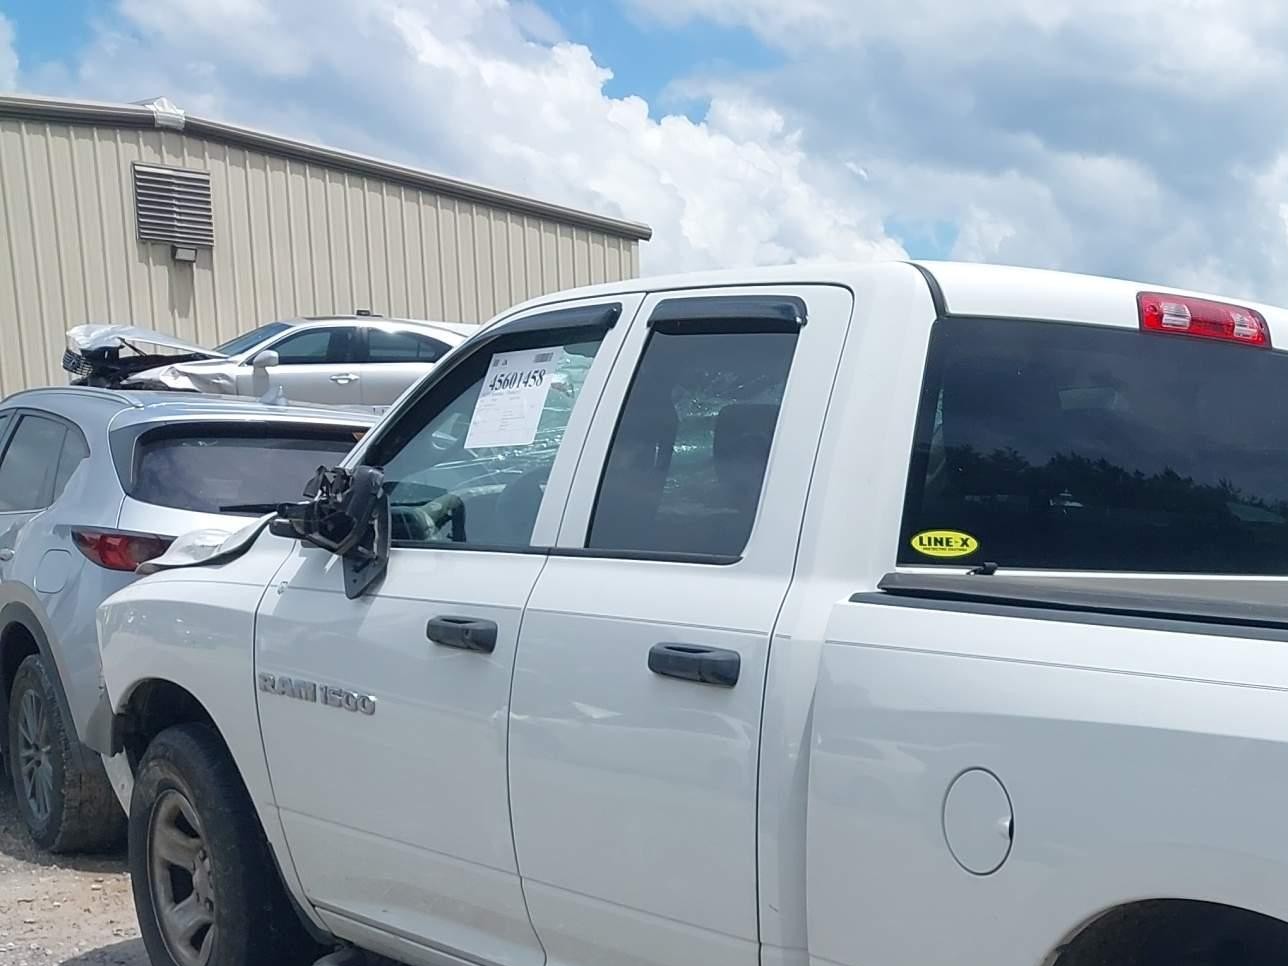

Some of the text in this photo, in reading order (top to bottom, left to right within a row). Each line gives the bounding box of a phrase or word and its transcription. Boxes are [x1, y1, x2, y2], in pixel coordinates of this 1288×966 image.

[489, 369, 546, 391] 45601458
[918, 535, 970, 548] LINE-X
[258, 671, 377, 716] RAM 1500
